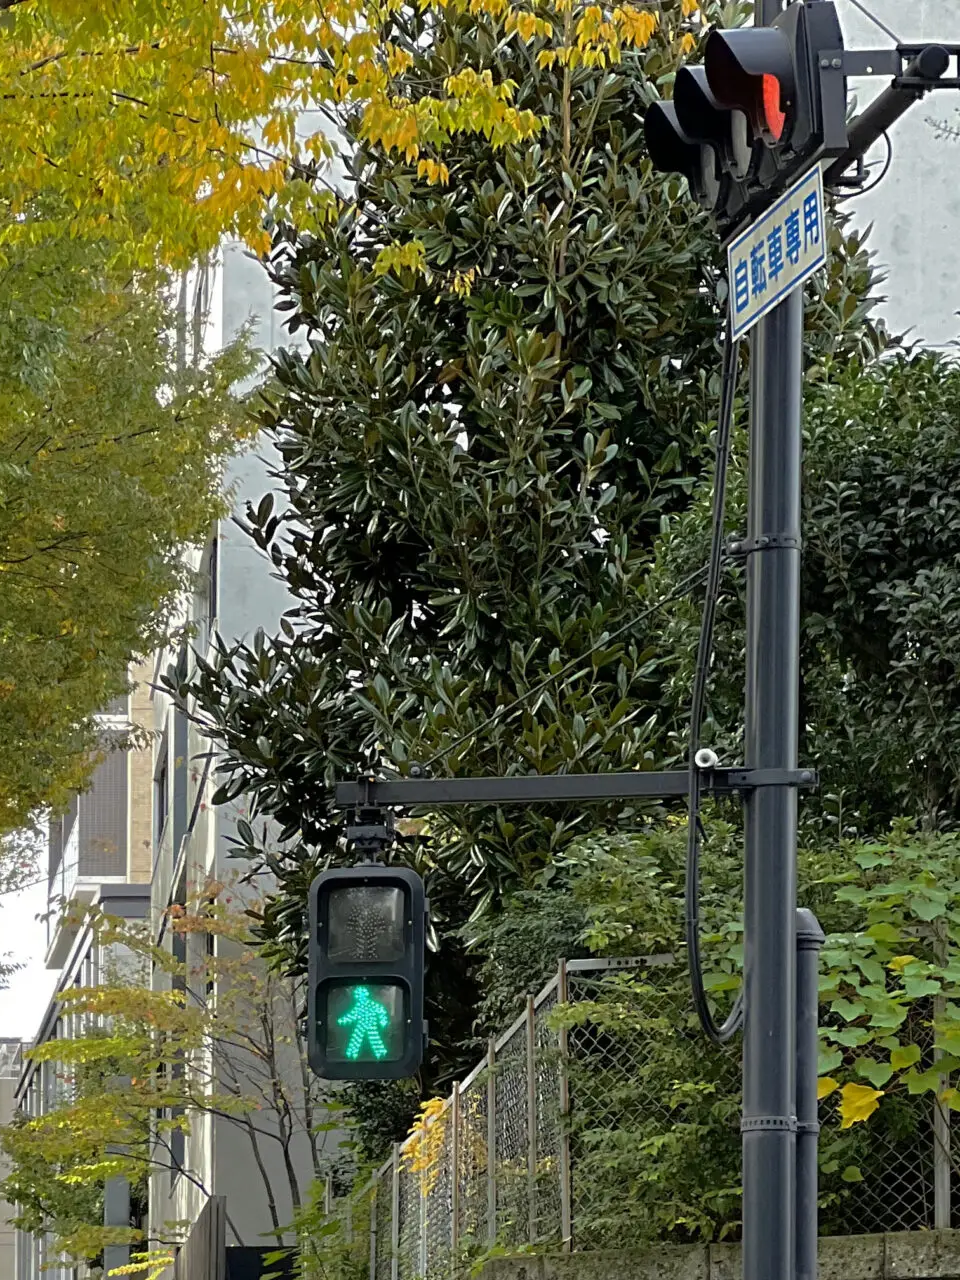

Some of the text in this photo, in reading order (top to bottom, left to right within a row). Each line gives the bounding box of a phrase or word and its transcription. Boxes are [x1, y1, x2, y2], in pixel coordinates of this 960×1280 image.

[735, 191, 819, 312] 自転車専用
